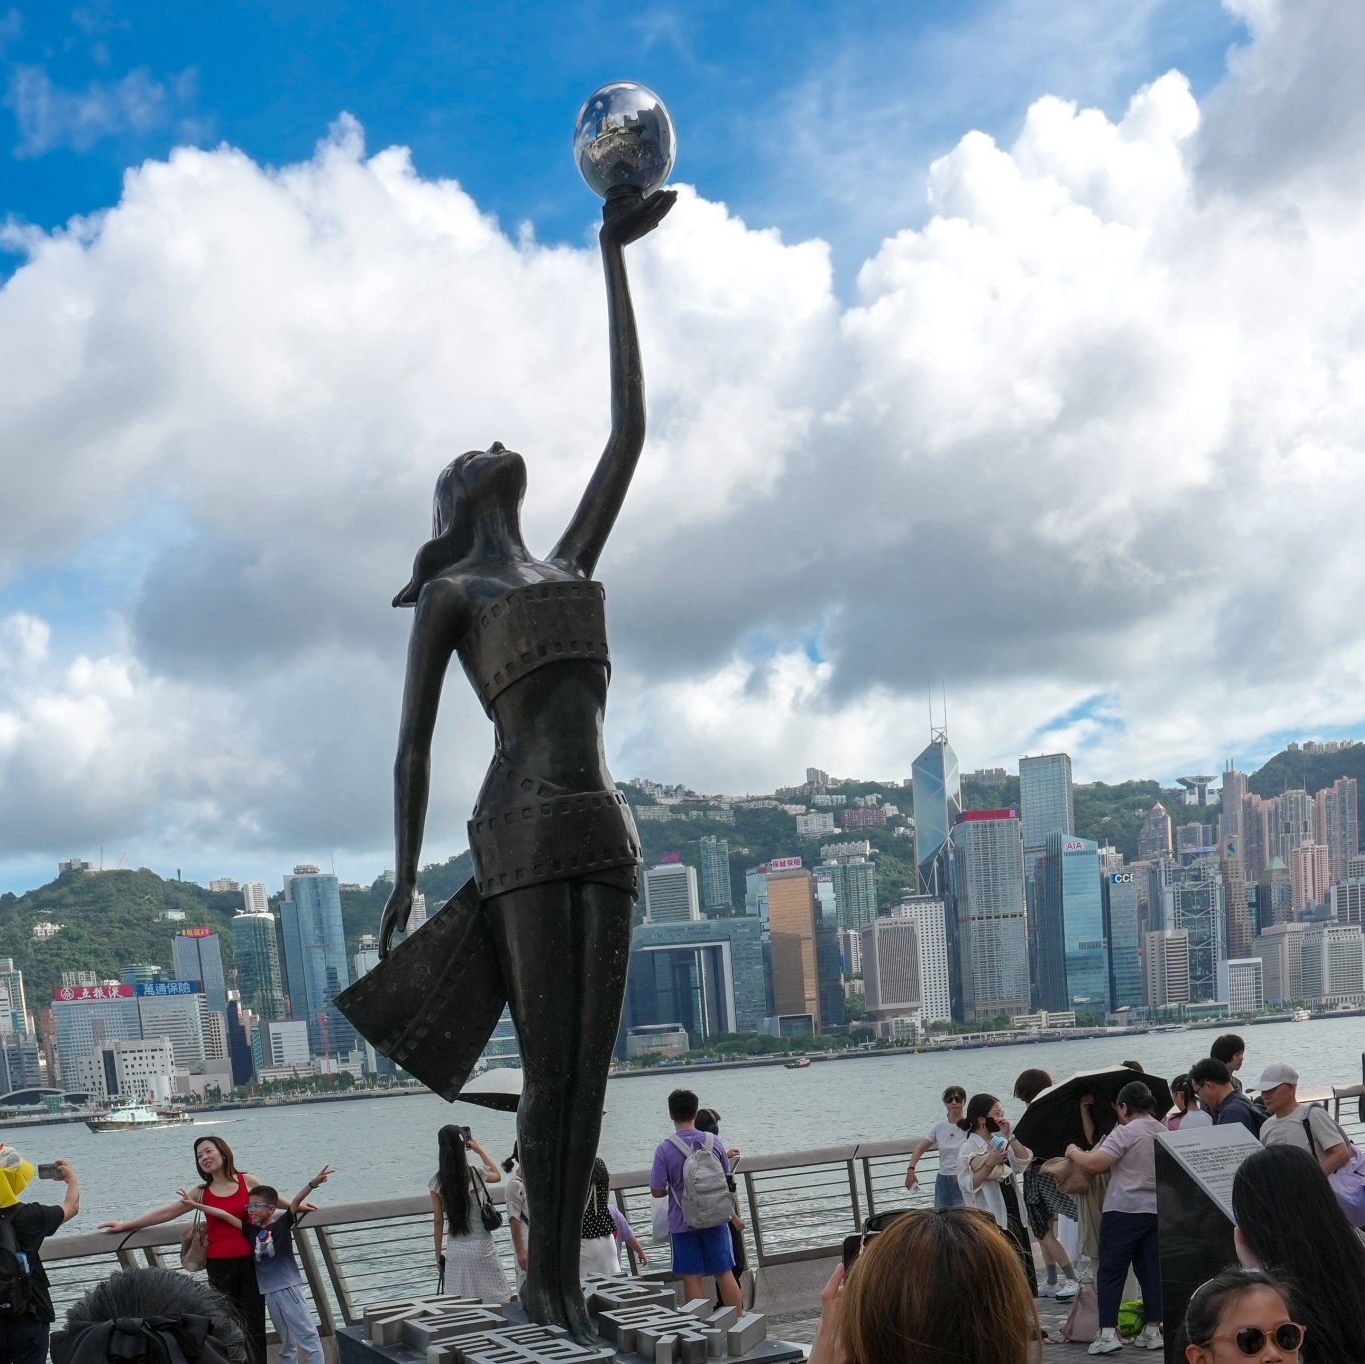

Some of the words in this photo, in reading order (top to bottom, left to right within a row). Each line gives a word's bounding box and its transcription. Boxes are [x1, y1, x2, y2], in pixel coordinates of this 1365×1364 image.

[1066, 842, 1083, 850] AIA
[143, 981, 191, 996] 萬通保險
